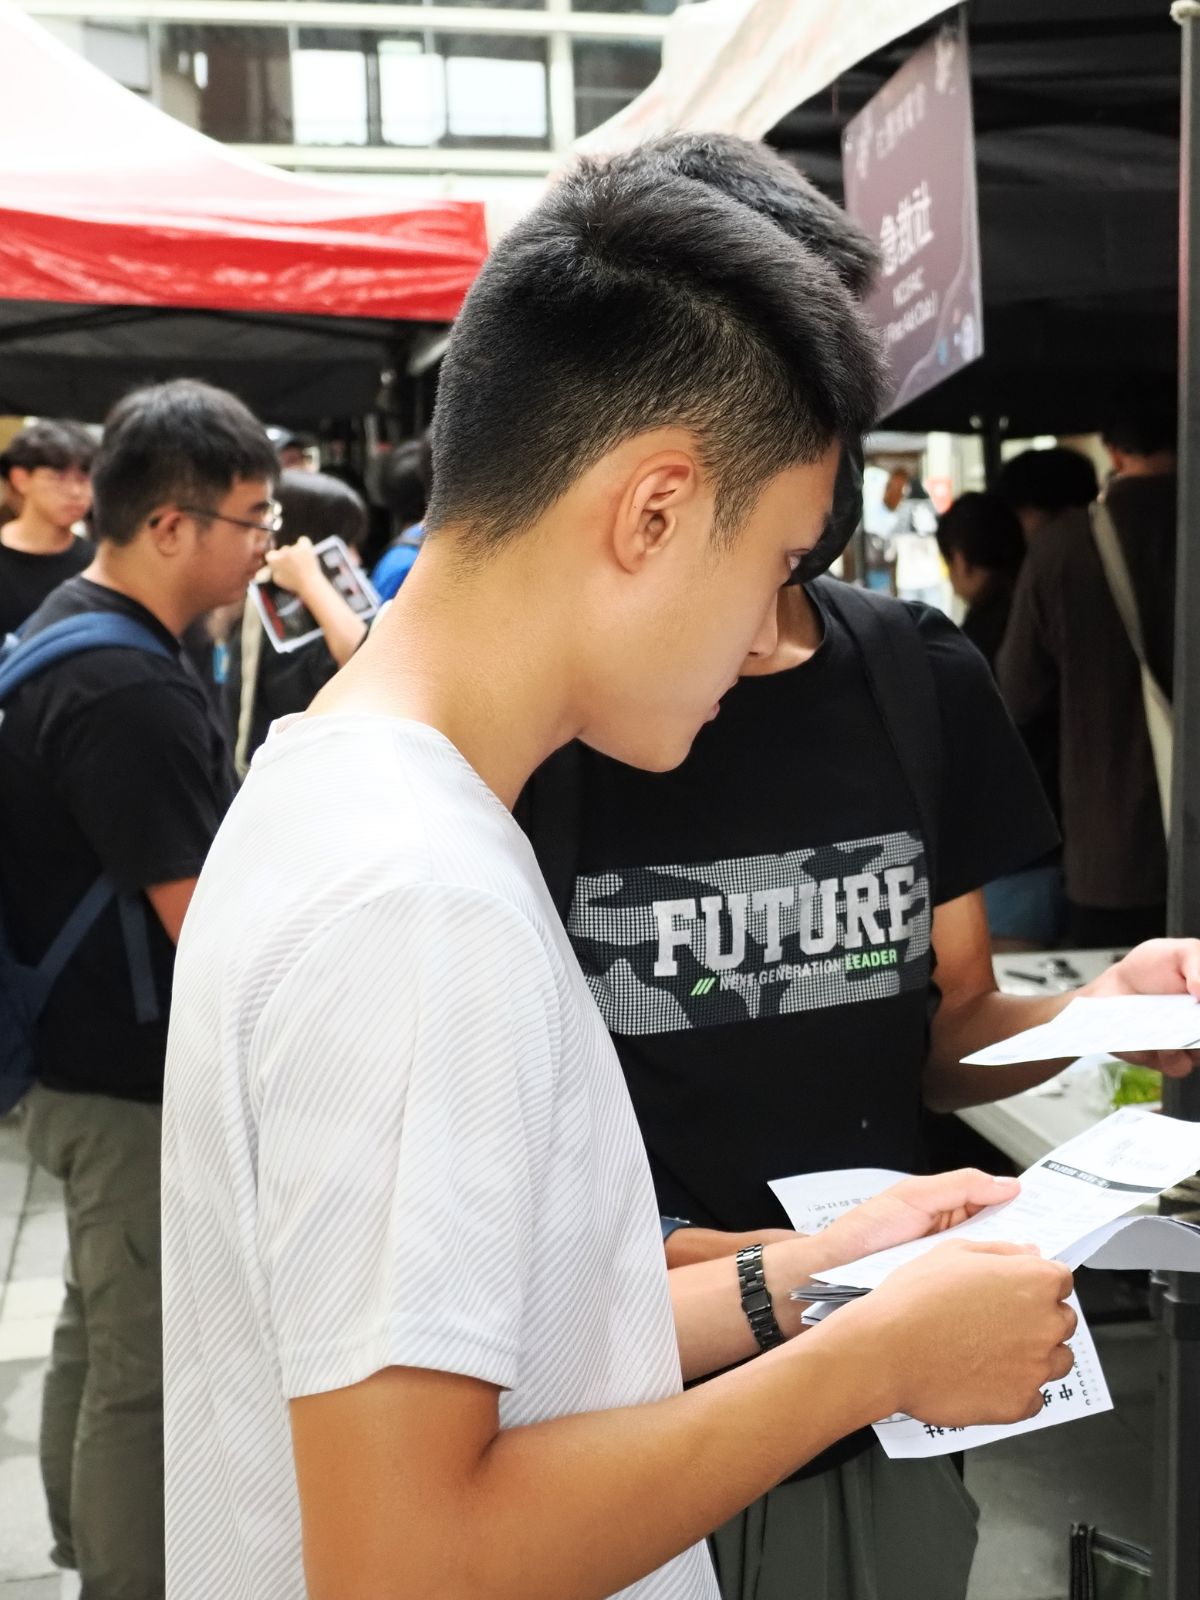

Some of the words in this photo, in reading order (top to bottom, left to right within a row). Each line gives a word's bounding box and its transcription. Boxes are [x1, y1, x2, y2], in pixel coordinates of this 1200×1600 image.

[652, 865, 915, 977] FUTURE
[759, 958, 841, 985] GENERATION
[845, 948, 897, 970] LEADER
